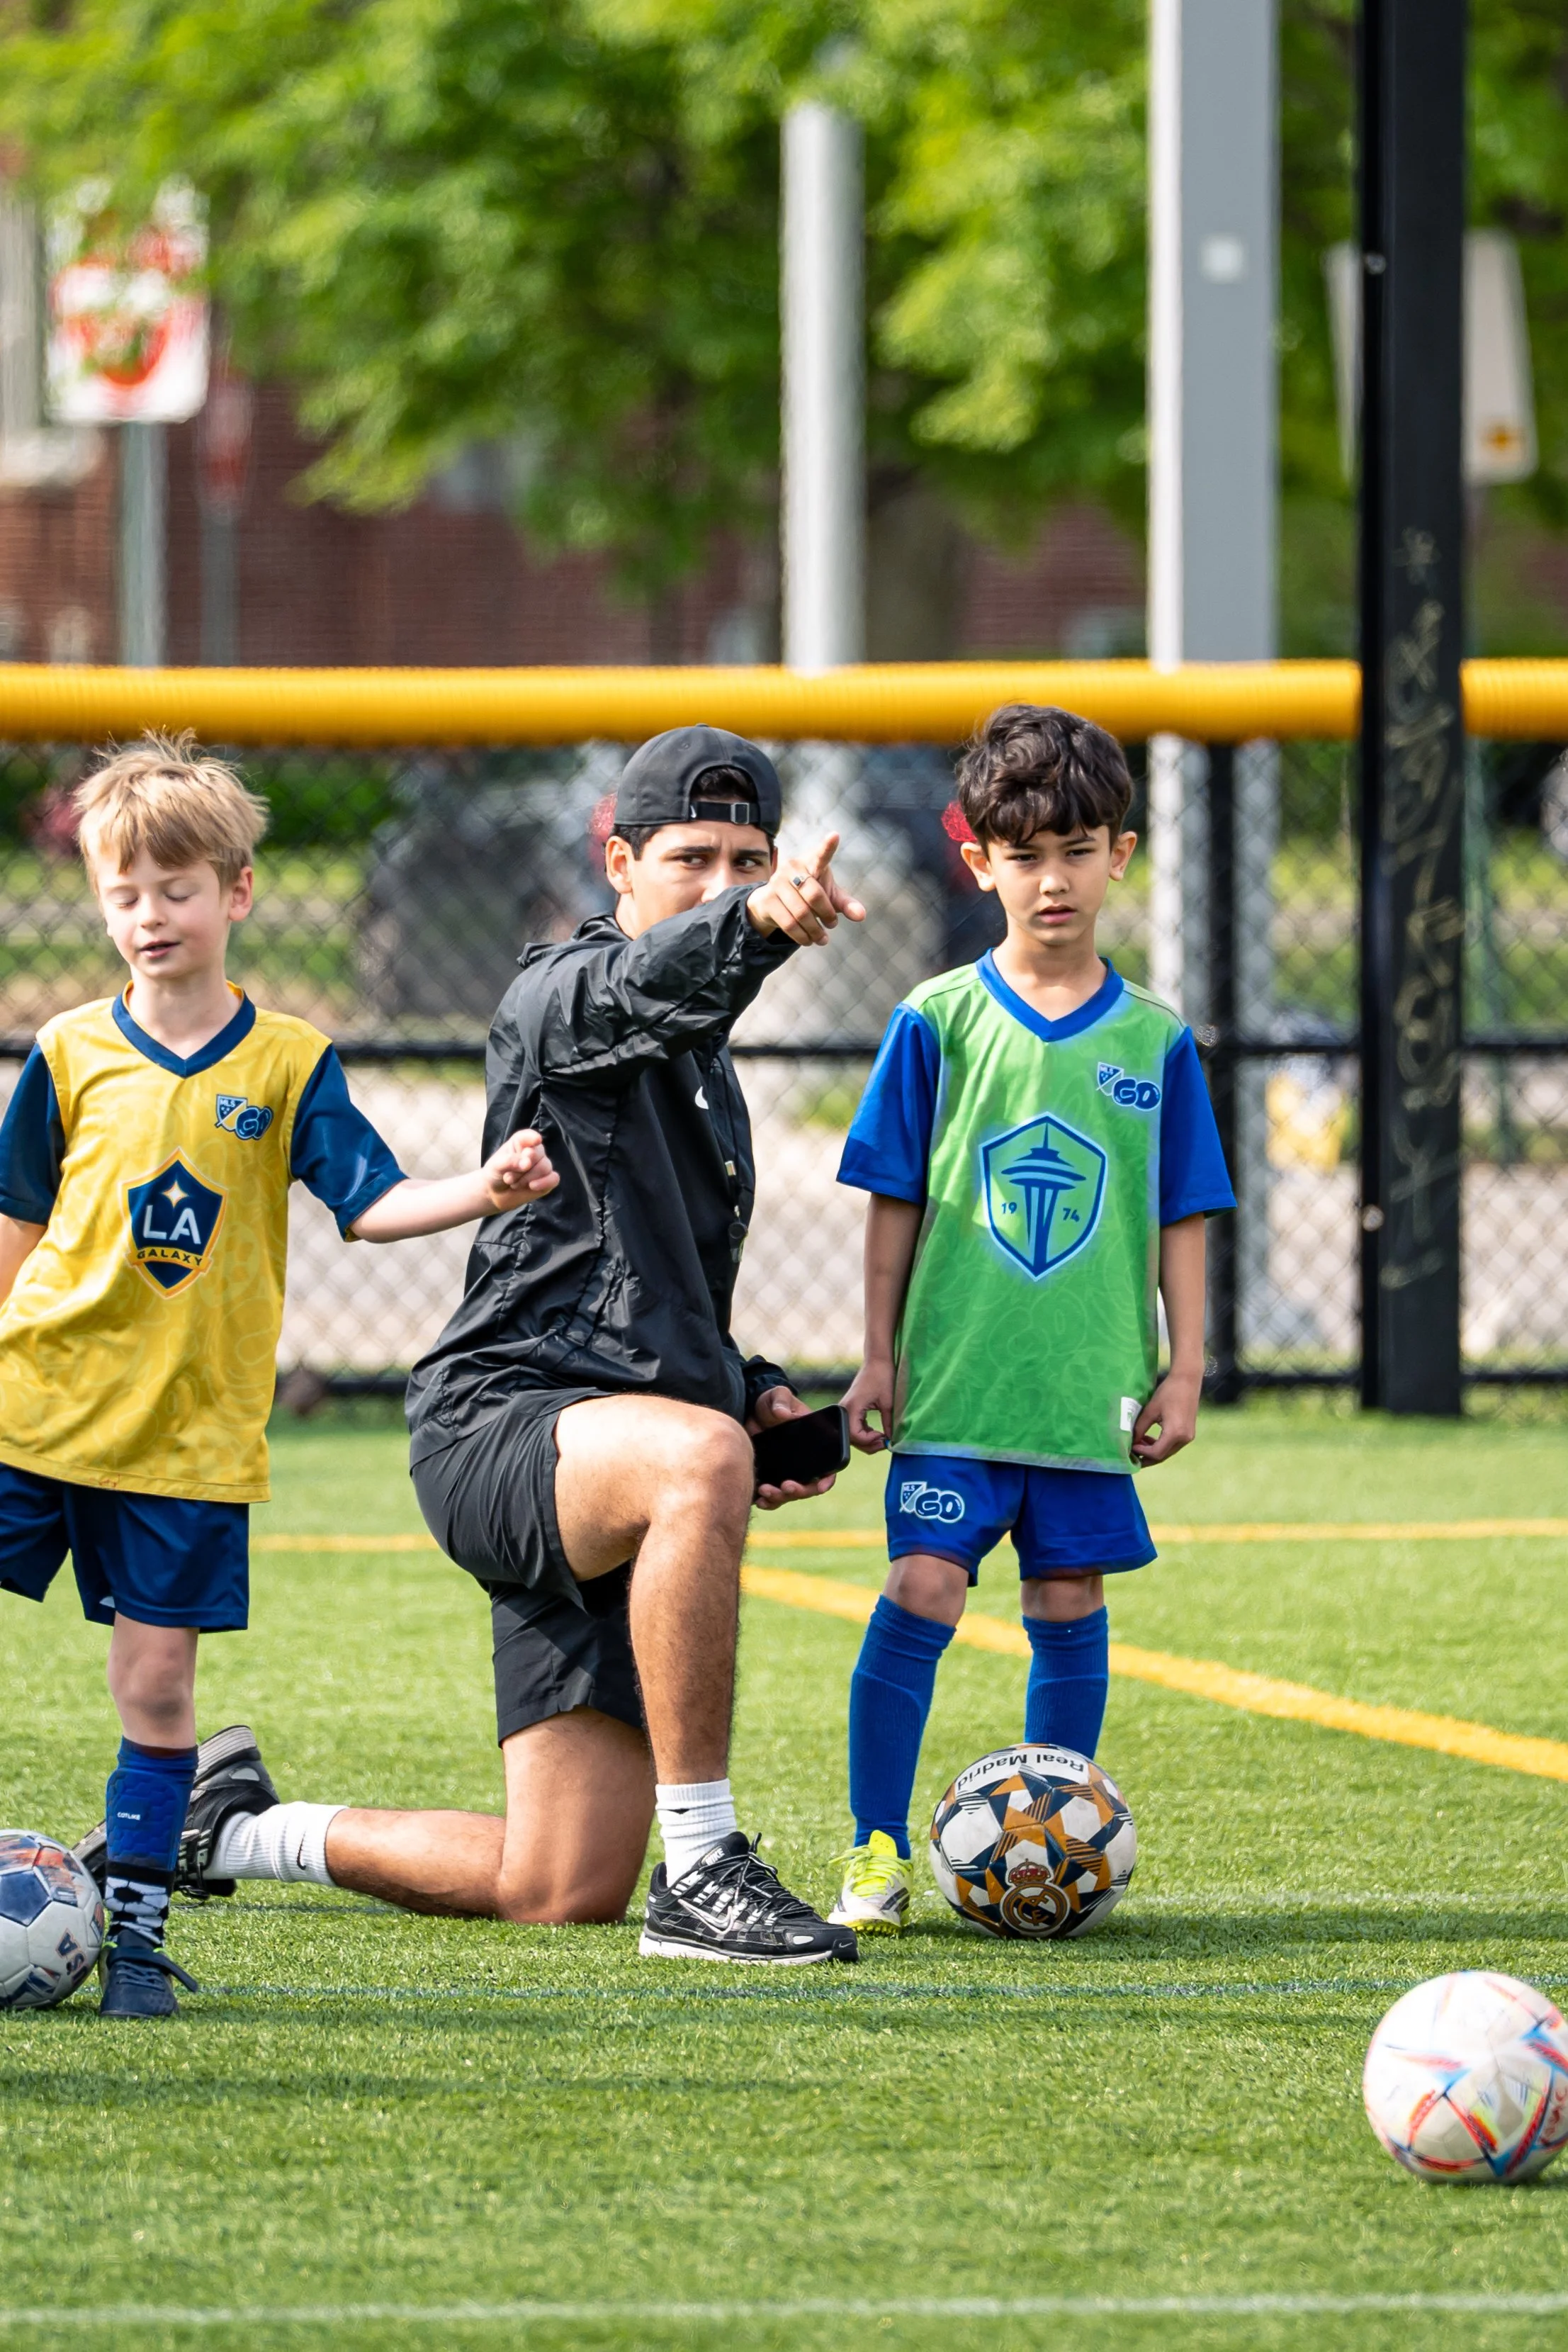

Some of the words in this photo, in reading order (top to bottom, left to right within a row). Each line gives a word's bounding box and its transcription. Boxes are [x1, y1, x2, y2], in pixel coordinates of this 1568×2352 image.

[220, 1098, 236, 1108] MLS
[1111, 1076, 1162, 1112] GO
[1001, 1202, 1017, 1214] 19
[143, 1205, 201, 1244] LA
[137, 1248, 203, 1266] GALAXY
[914, 1487, 965, 1524] GO
[958, 1754, 1027, 1790] Madrid
[1036, 1753, 1085, 1772] Real
[705, 1847, 726, 1867] NIKE
